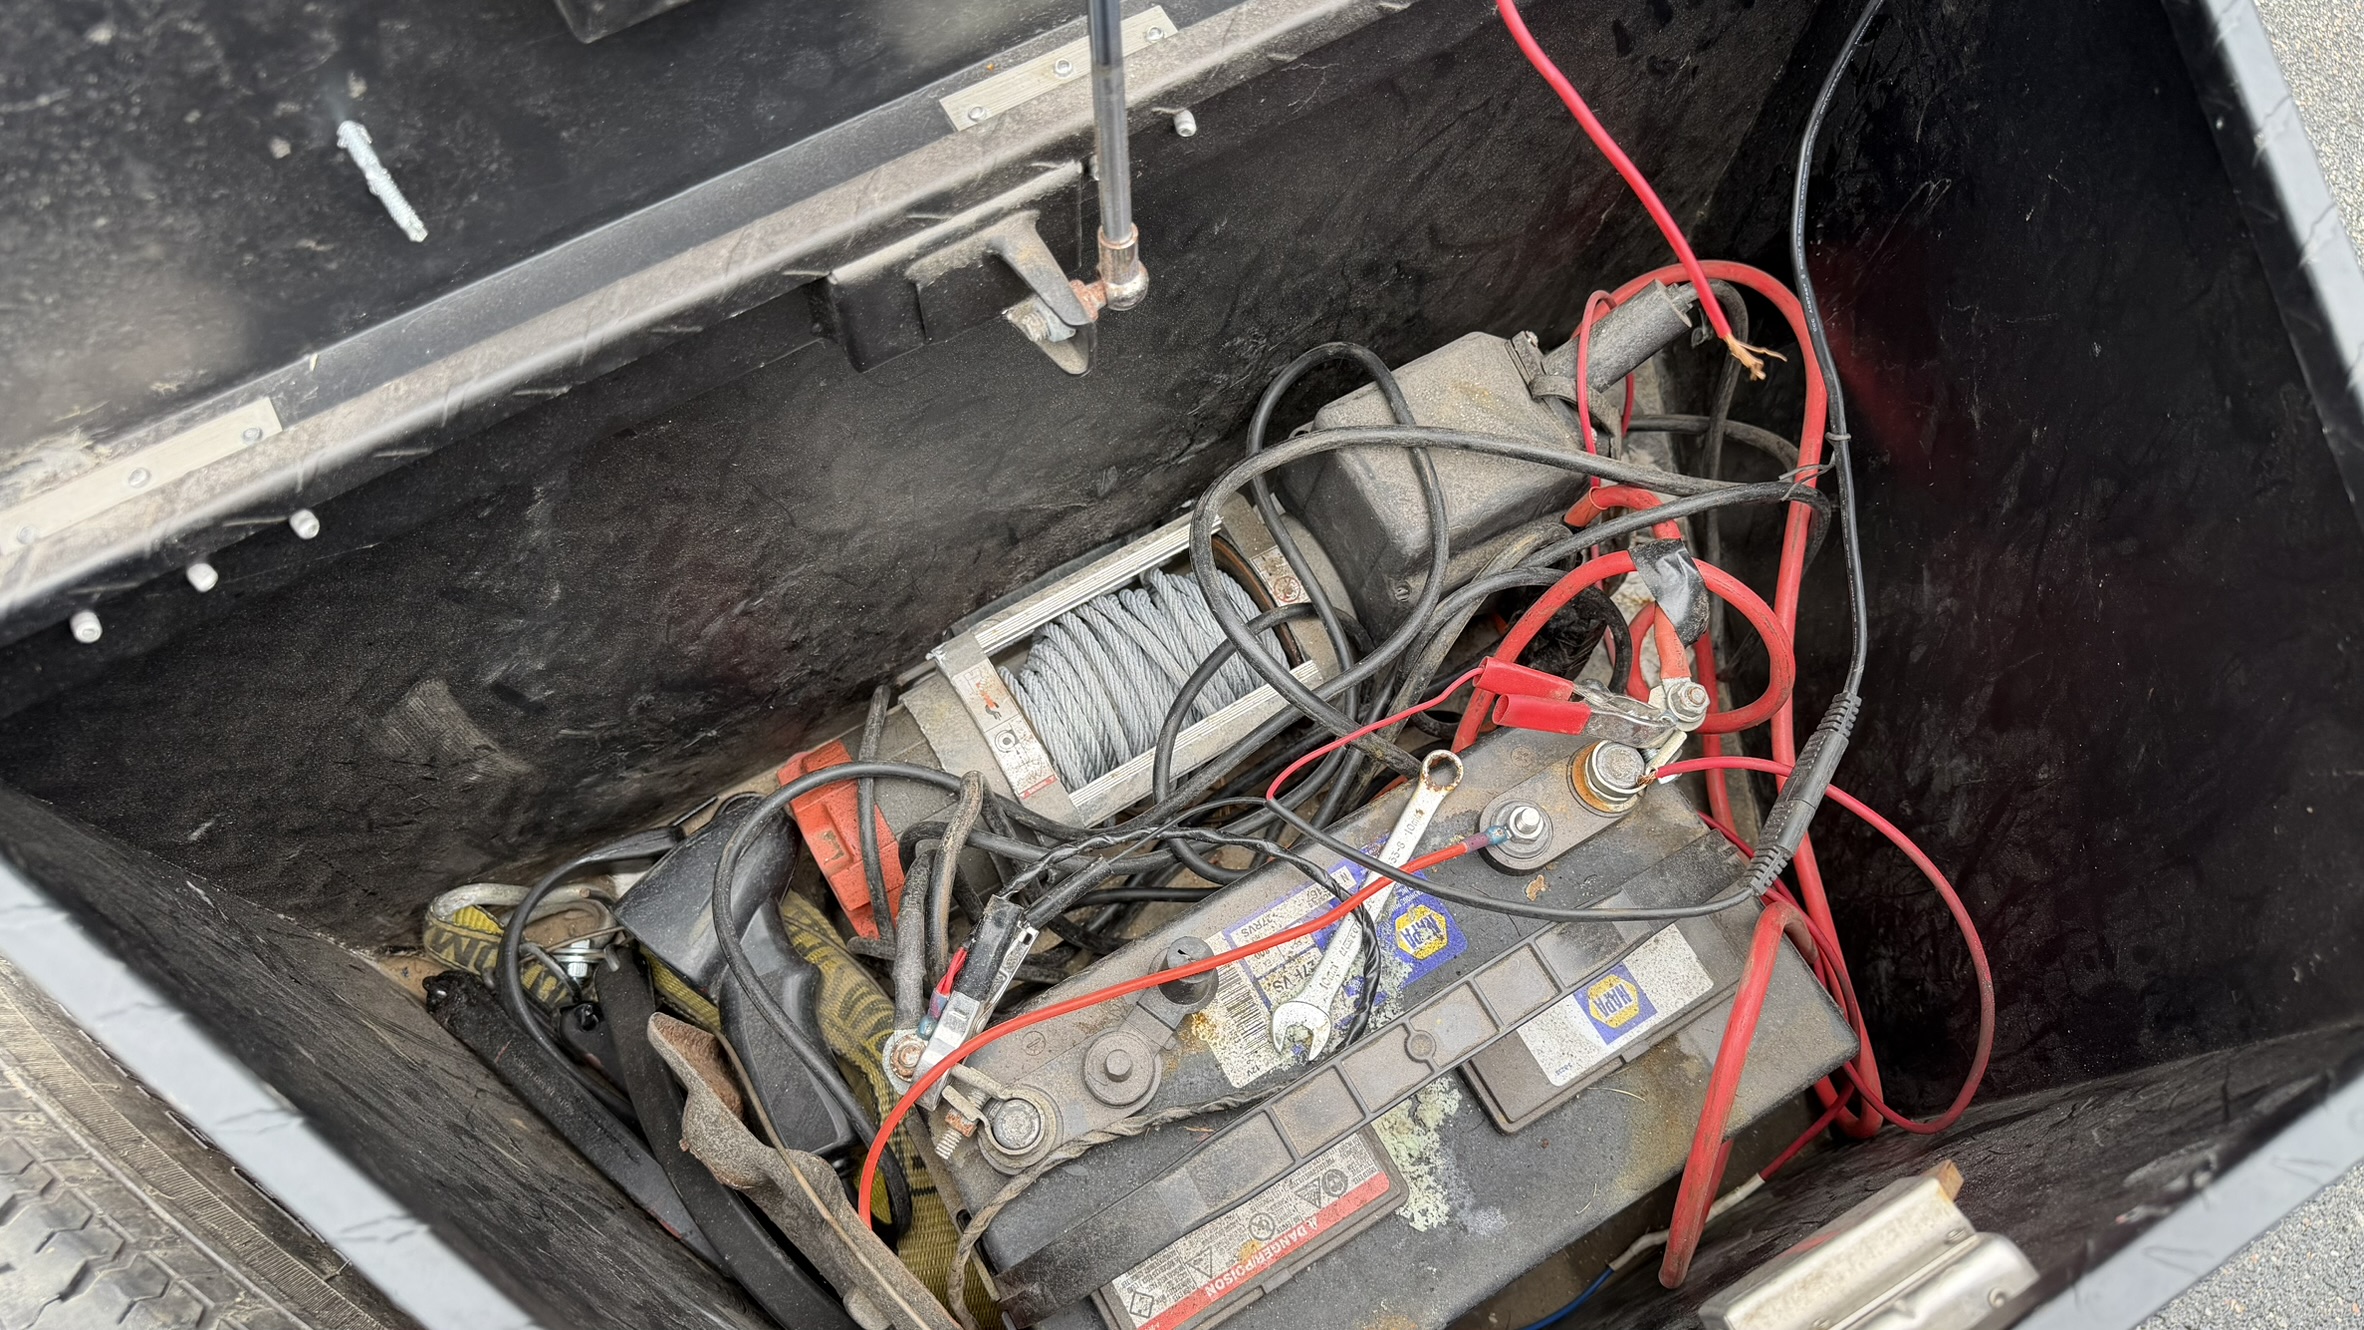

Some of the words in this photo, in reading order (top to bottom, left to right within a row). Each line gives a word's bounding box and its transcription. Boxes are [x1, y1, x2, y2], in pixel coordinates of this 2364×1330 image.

[1591, 982, 1633, 1019] NAPA
[1244, 1063, 1261, 1077] 12V
[1201, 1223, 1309, 1298] DANGER/POISON
